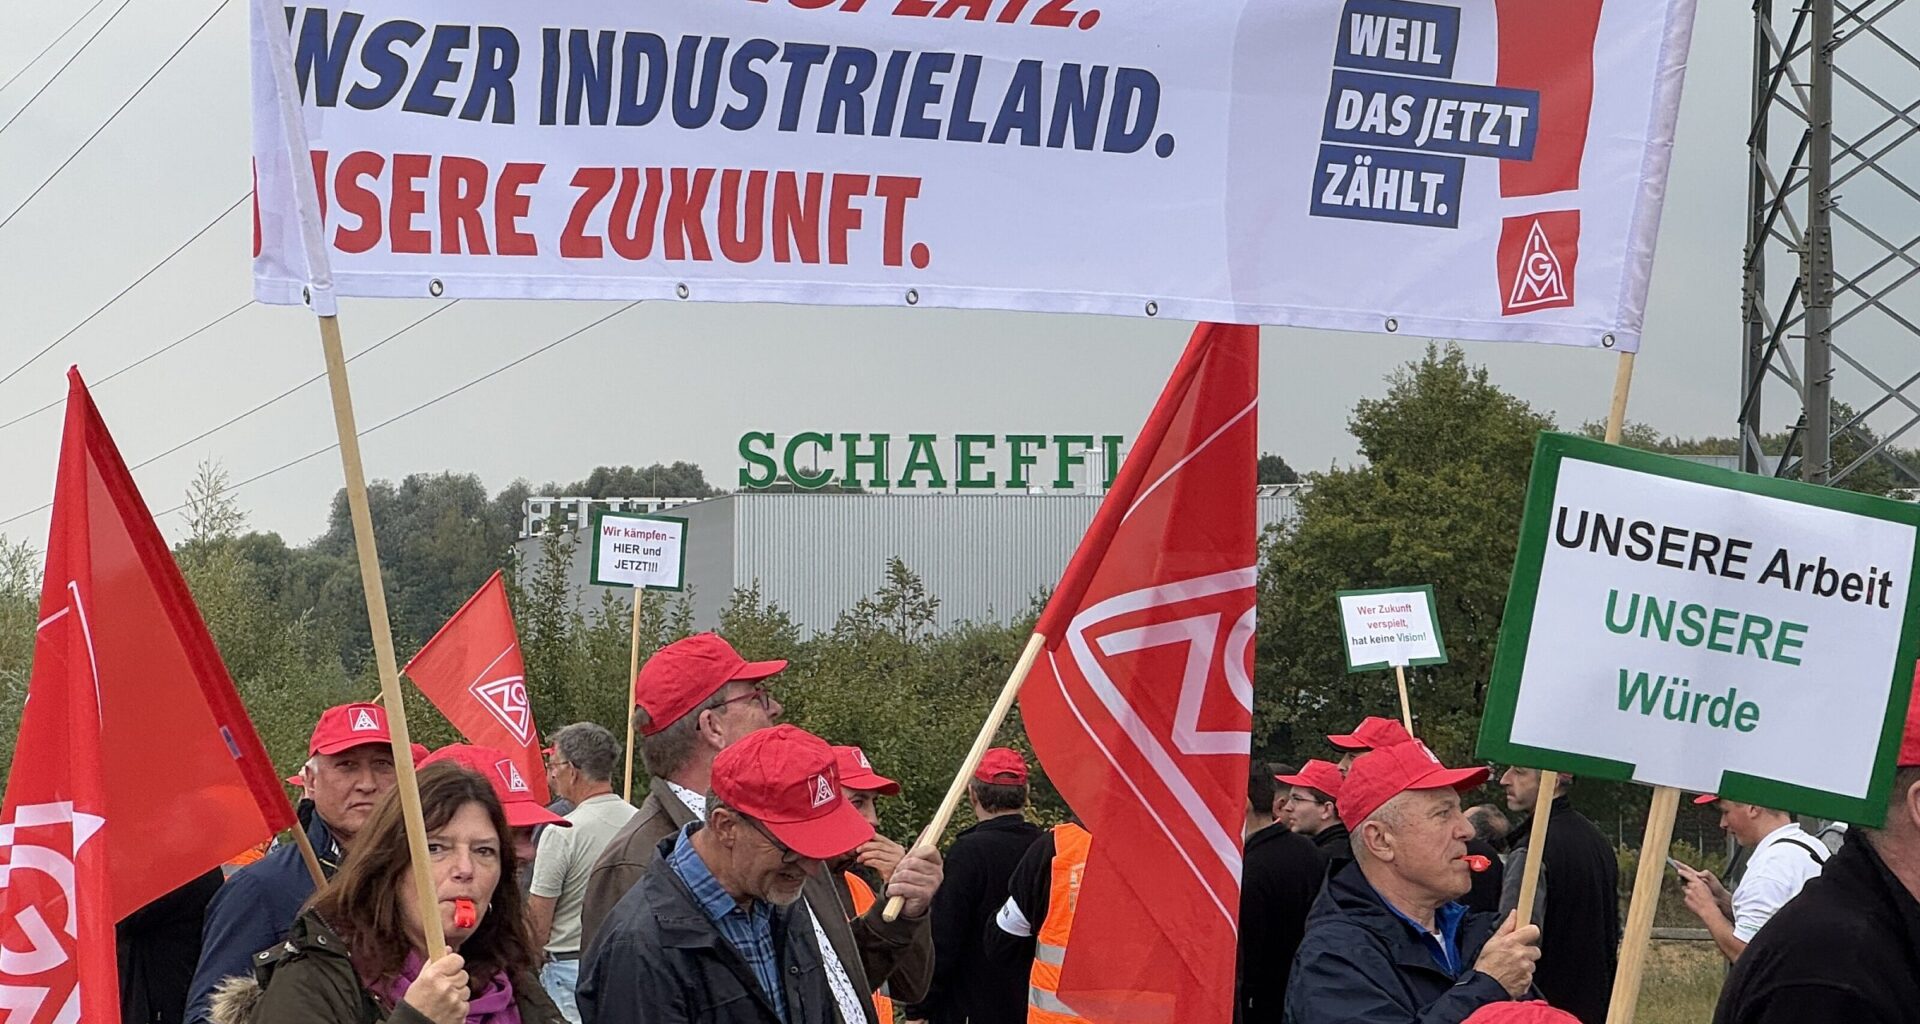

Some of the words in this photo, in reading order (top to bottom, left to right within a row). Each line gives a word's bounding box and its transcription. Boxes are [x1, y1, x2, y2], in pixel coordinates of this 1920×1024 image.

[1350, 13, 1442, 65] WEIL
[285, 6, 520, 125] NSER
[539, 28, 1176, 159] INDUSTRIELAND.
[1334, 89, 1416, 136] DAS
[1413, 98, 1530, 148] JETZT
[253, 150, 546, 257] SERE
[559, 167, 931, 269] ZUKUNFT.
[1321, 154, 1448, 216] ZÄHLT.
[602, 525, 622, 537] Wir
[623, 527, 667, 542] kämpfen
[613, 542, 640, 555] HIER
[642, 546, 662, 557] und
[1555, 506, 1753, 581] UNSERE
[1757, 547, 1893, 609] Arbeit
[614, 559, 658, 572] JETZT!!!
[1356, 606, 1377, 616] Wer
[1378, 603, 1412, 614] Zukunft
[1366, 618, 1409, 630] verspielt,
[1605, 589, 1809, 667] UNSERE
[1351, 636, 1368, 646] hat
[1369, 634, 1395, 645] keine
[1396, 631, 1427, 643] Vision!
[1617, 667, 1761, 733] Würde
